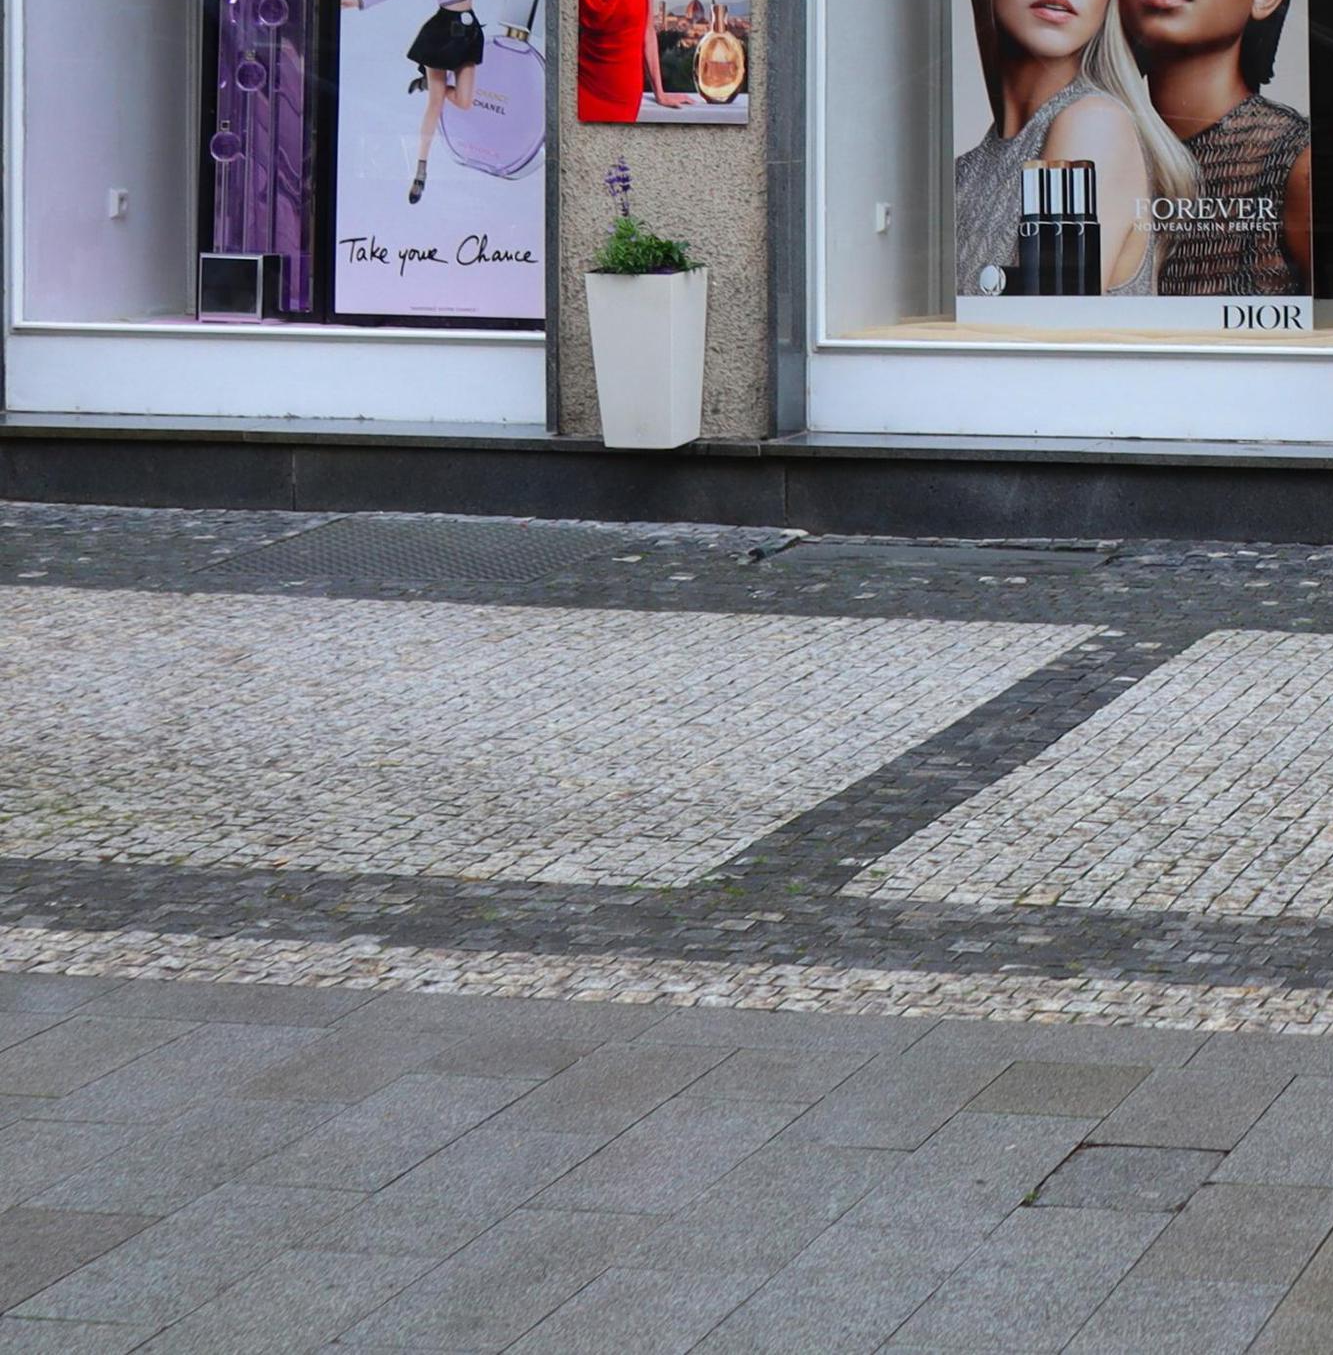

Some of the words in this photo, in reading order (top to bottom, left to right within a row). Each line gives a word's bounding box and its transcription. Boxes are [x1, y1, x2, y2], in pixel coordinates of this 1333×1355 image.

[472, 98, 507, 116] CHANEL
[1134, 197, 1278, 220] FOREVER
[1133, 221, 1193, 232] NOUVEAU
[1196, 221, 1225, 232] SKIN
[1228, 221, 1280, 232] PERFECT
[338, 235, 391, 264] Take
[398, 247, 449, 277] your
[456, 233, 539, 266] Chance
[1222, 304, 1304, 331] DIOR
